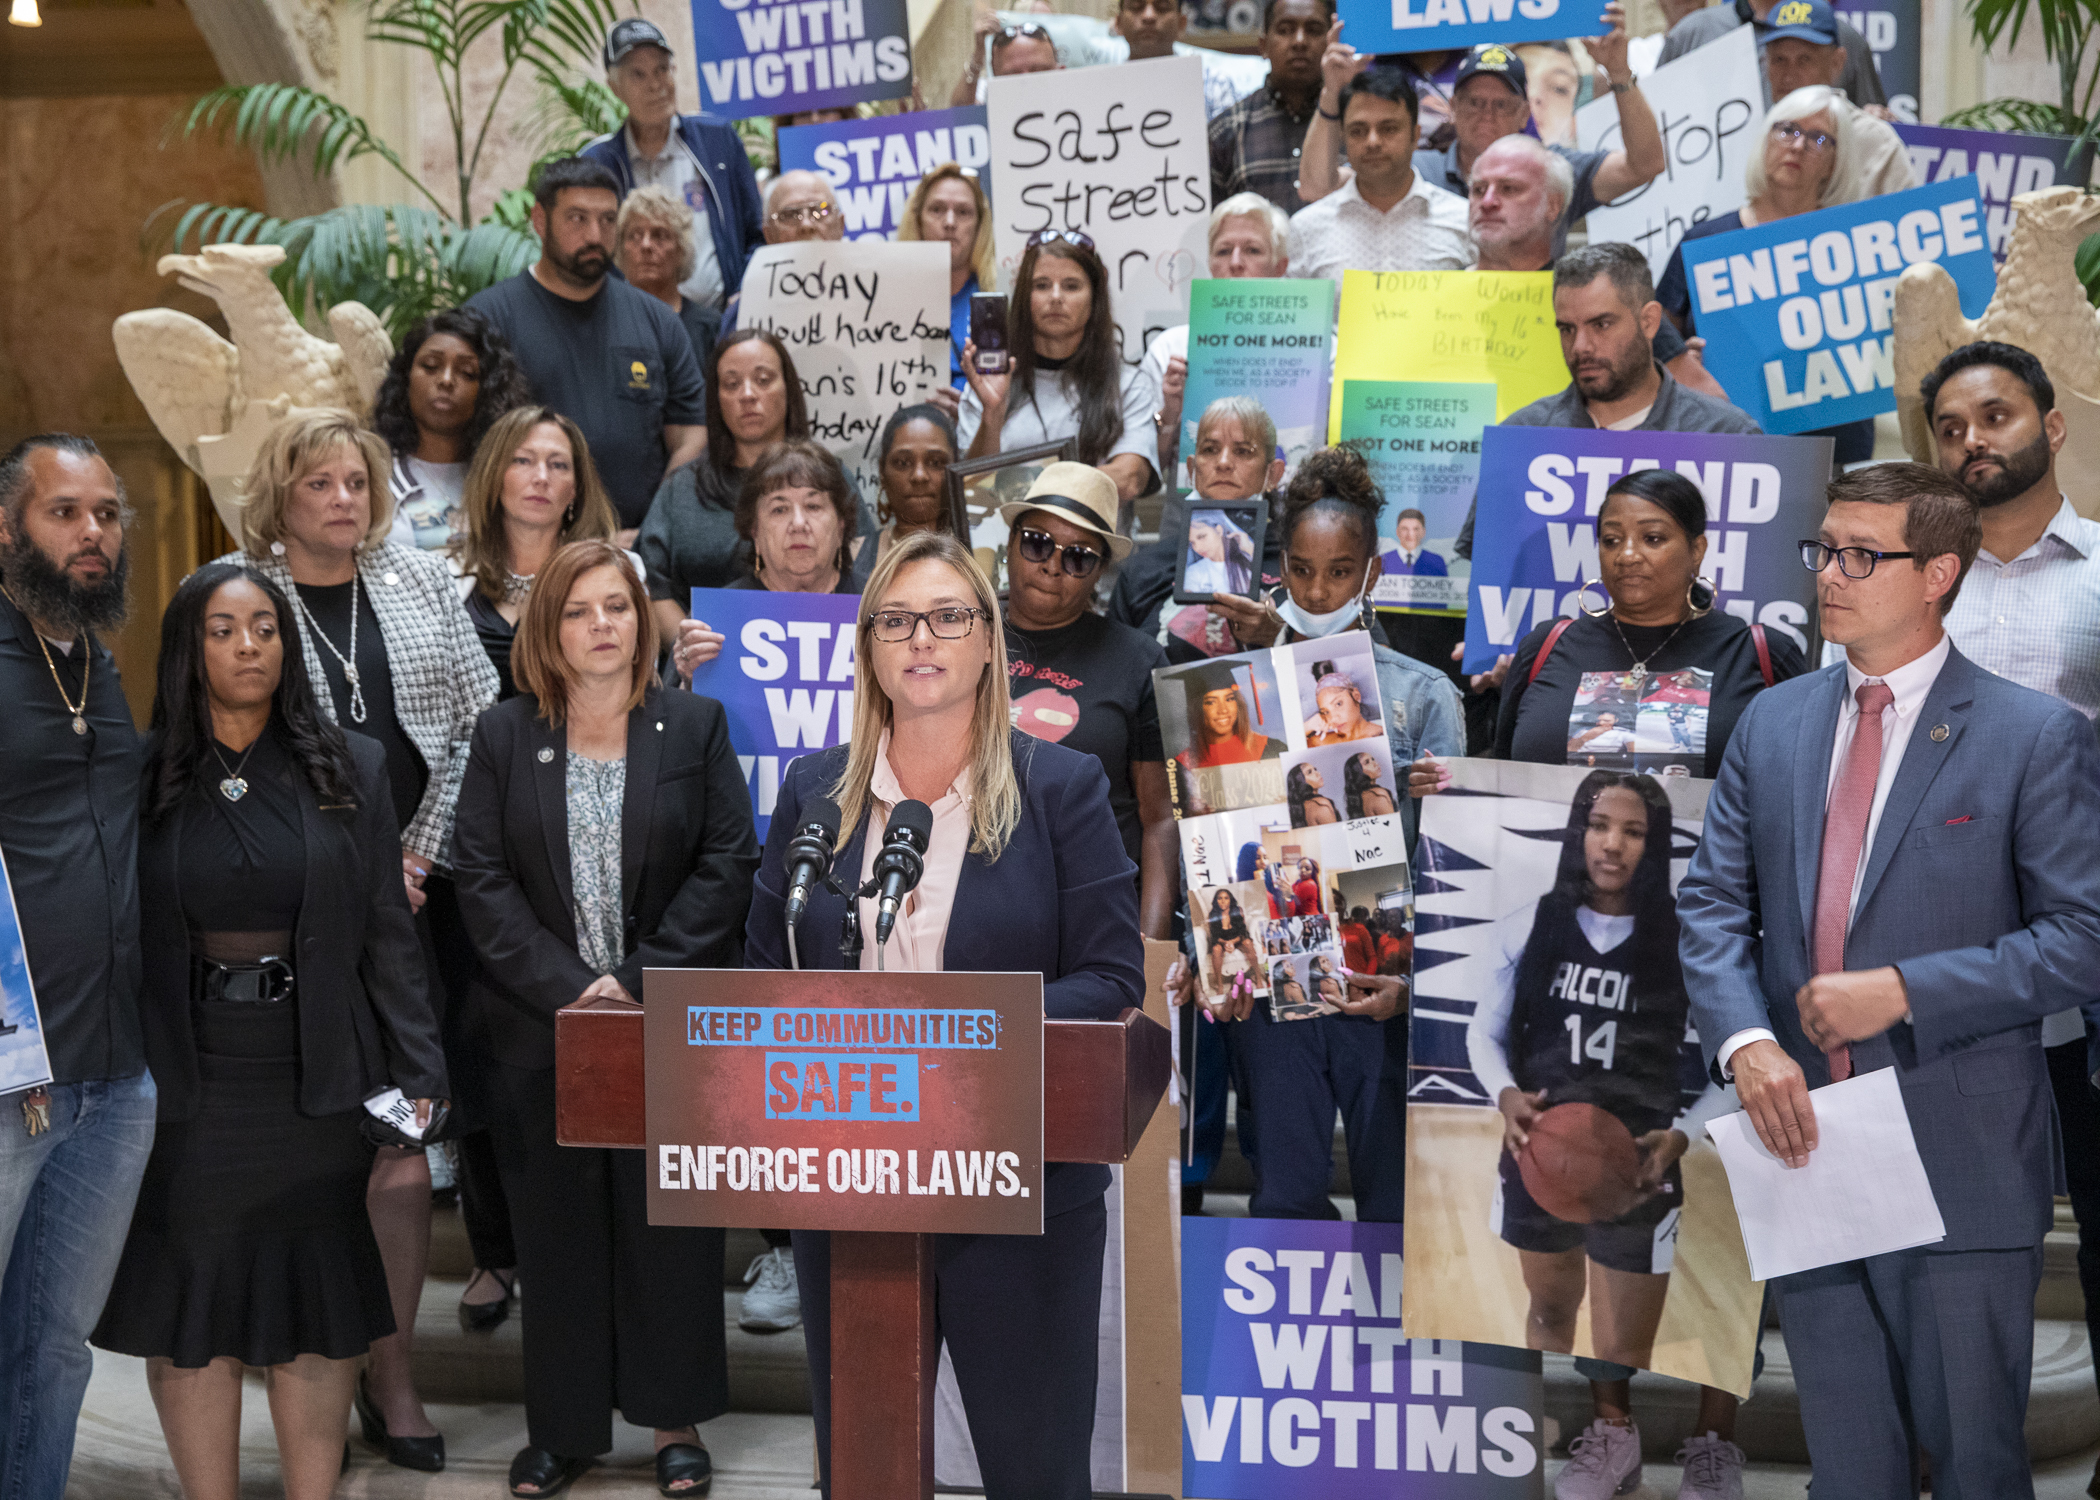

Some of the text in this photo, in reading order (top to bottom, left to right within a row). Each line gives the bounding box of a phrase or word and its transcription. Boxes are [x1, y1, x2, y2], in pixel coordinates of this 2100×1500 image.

[736, 0, 865, 54] WITH
[701, 36, 910, 104] VICTIMS
[814, 124, 990, 189] STAND
[1010, 103, 1181, 168] Safe
[1011, 156, 1206, 233] Streets
[1908, 144, 2056, 203] TAND
[1693, 198, 1984, 314] ENFORCE
[1212, 294, 1309, 309] SAFE STREETS
[1225, 311, 1296, 325] FOR SEAN
[1197, 335, 1323, 347] NOT ONE MORE!
[1213, 357, 1240, 366] WHEN
[1242, 357, 1267, 366] DOES
[1269, 357, 1277, 366] IT
[1203, 368, 1230, 376] WHEN
[1274, 368, 1311, 377] SOCIETY
[1214, 378, 1246, 388] DECIDE
[1249, 378, 1261, 387] TO
[1263, 378, 1287, 388] STOP
[1763, 334, 1896, 414] LAW
[1365, 396, 1469, 413] SAFE STREETS
[1380, 413, 1456, 429] FOR SEAN
[1353, 437, 1480, 453] OT ONE MORE
[1422, 485, 1446, 495] STOP
[1433, 475, 1473, 484] SOCIETY
[1524, 453, 1782, 525] STND
[1401, 579, 1454, 590] TOOMEY
[740, 618, 858, 682] STA
[689, 1011, 995, 1046] KEEP COMMUNITIES
[1564, 1013, 1617, 1070] 14
[769, 1060, 913, 1115] SAFE.
[659, 1144, 1029, 1198] ENFORCE OUR LAWS.
[1223, 1247, 1404, 1319] STA
[1249, 1322, 1463, 1396] WITH
[1181, 1394, 1537, 1477] VICTIMS
